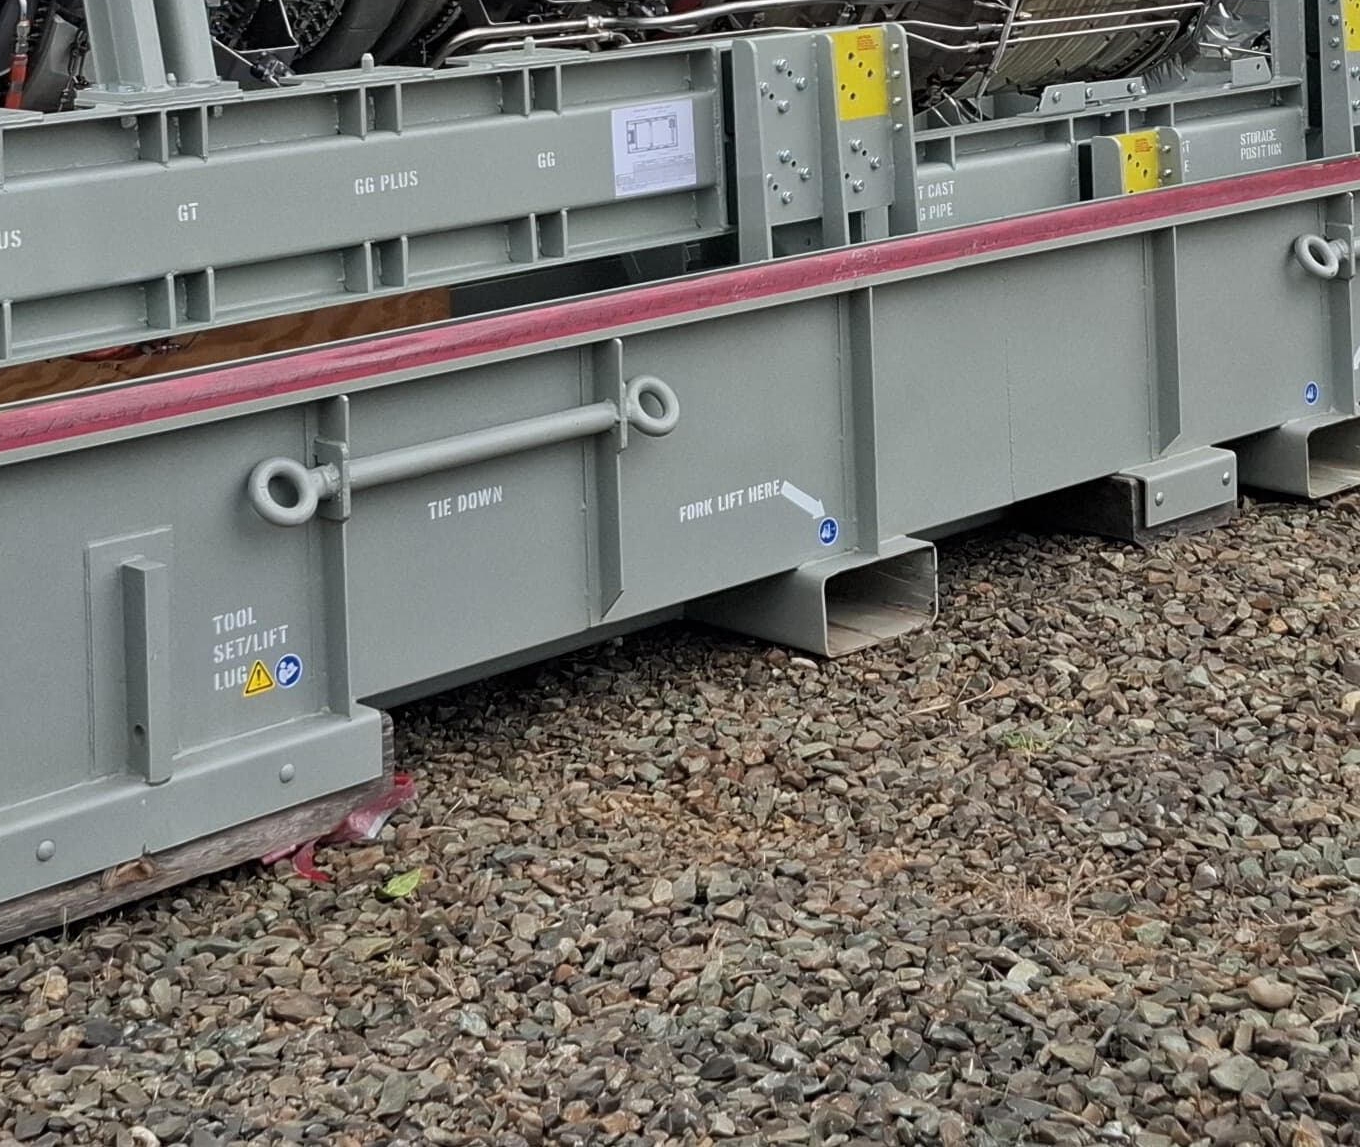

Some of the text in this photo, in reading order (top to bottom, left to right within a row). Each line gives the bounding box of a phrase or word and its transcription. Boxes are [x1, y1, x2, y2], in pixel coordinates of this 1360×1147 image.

[1240, 128, 1277, 146] STORAGE
[537, 151, 556, 169] GG
[1240, 142, 1282, 161] POSITION
[355, 170, 419, 195] GG PLUS
[928, 180, 955, 198] CAST
[177, 202, 199, 222] GT
[929, 202, 953, 220] PIPE
[427, 485, 503, 520] TIE DOWN
[679, 479, 781, 523] FORK LIFT HERE
[212, 607, 257, 635] TOOL
[213, 624, 289, 664] SET/LIFT
[215, 665, 248, 691] LUG
